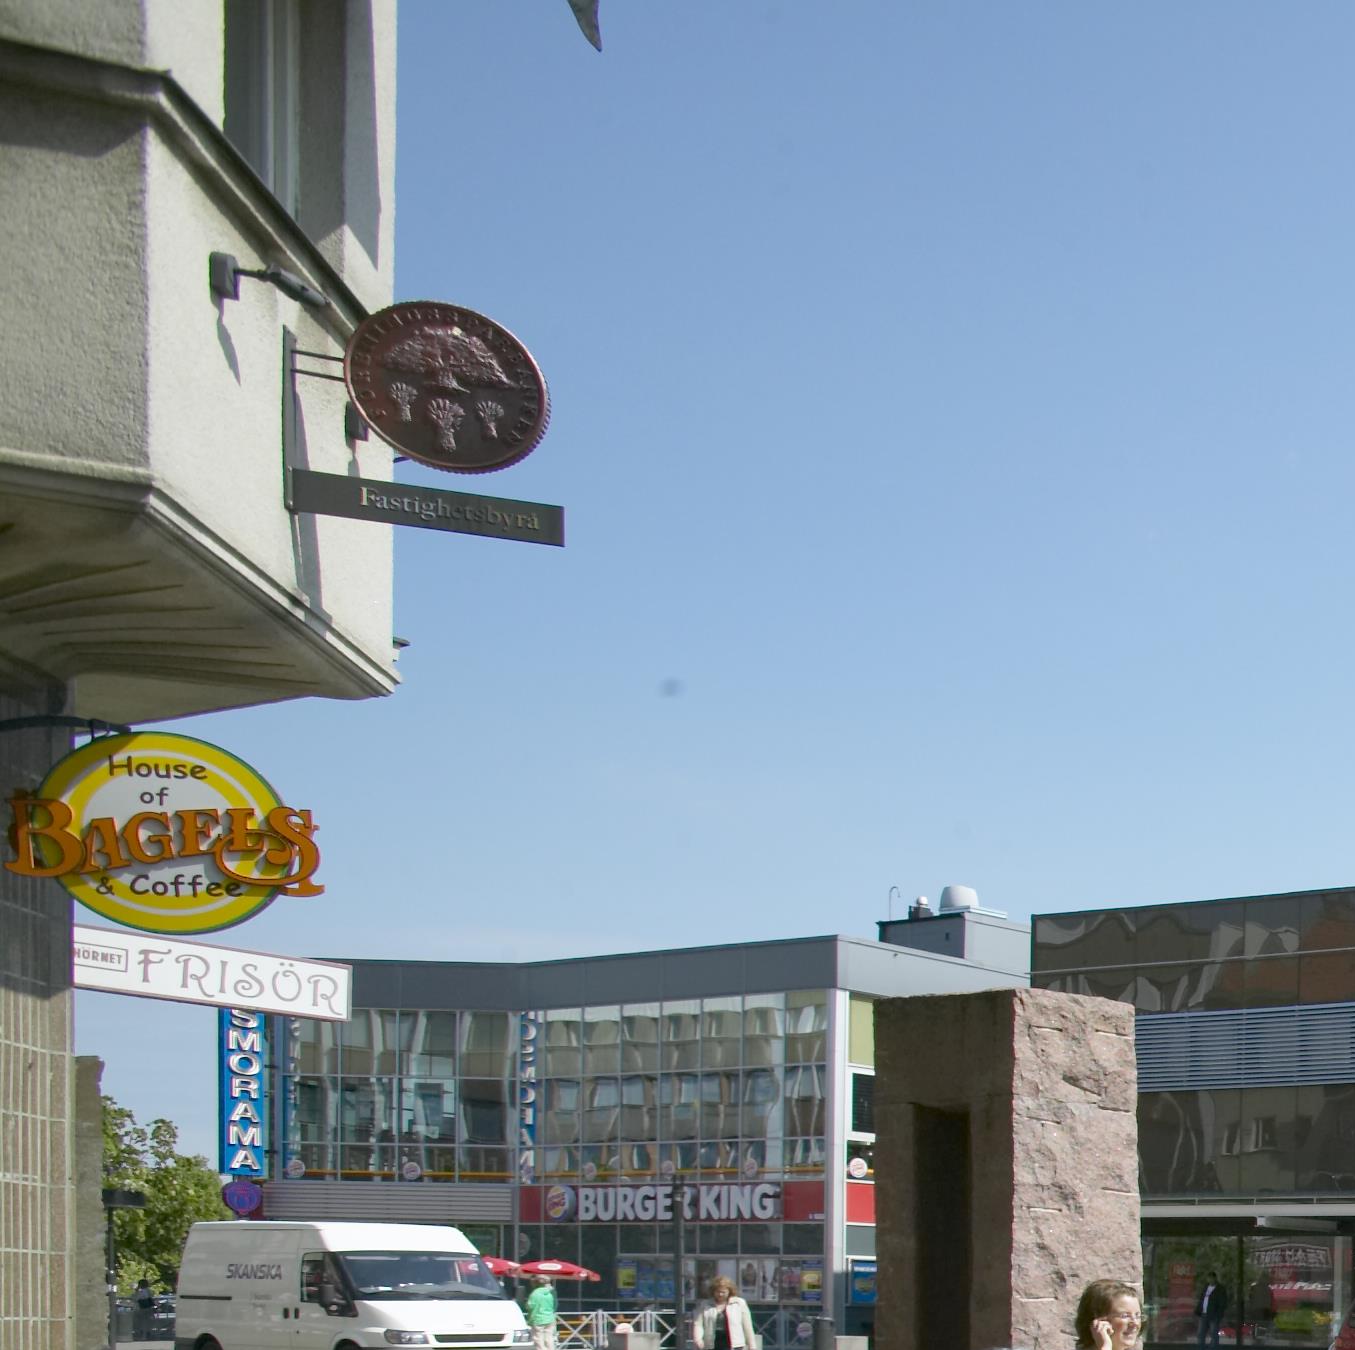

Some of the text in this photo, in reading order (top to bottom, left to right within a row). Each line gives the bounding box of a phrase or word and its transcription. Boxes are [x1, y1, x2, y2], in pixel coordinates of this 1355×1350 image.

[360, 486, 540, 531] Fastighetsbyrå
[109, 754, 208, 780] House
[139, 787, 170, 806] of
[4, 799, 321, 887] BAGELS
[95, 874, 244, 898] & Coffee
[137, 948, 343, 1016] FRISÖR
[700, 1183, 777, 1220] KING
[226, 1263, 282, 1280] SKANSKA
